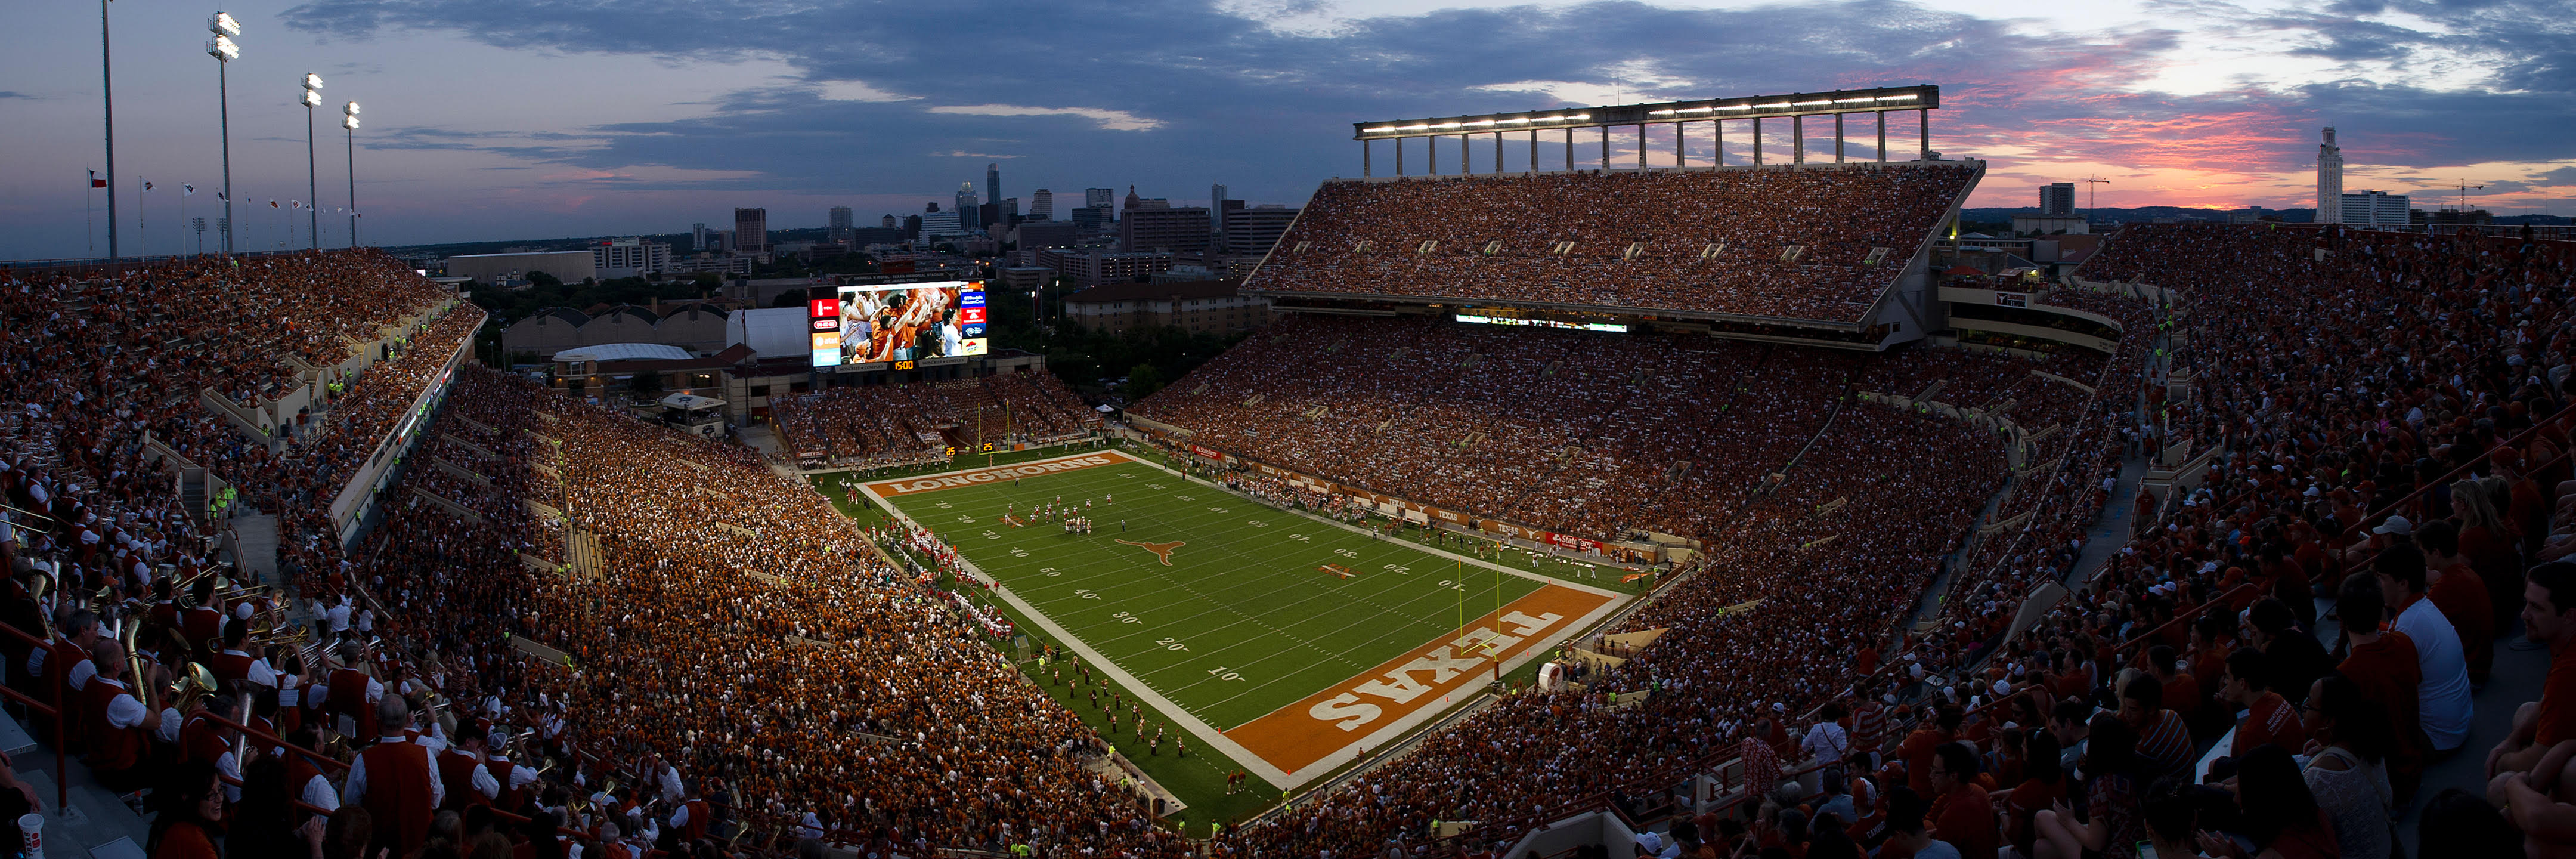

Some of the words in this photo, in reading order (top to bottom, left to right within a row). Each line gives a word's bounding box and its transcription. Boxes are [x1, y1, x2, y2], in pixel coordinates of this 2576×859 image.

[895, 360, 914, 370] 15:00
[946, 447, 955, 455] 25
[984, 443, 993, 451] 25
[890, 456, 1111, 493] LONGHORNS
[1261, 465, 1275, 474] TEXAS
[1300, 475, 1315, 485] TEXAS
[1388, 498, 1406, 509] TEXAS
[1438, 510, 1457, 521] TEXAS
[982, 530, 1001, 539] 30
[1498, 523, 1519, 535] TEXAS
[1009, 548, 1029, 557] 40
[1039, 567, 1061, 577] 50
[1383, 564, 1410, 573] 20
[1074, 589, 1098, 600] 40
[1112, 611, 1138, 624] 30
[1155, 637, 1185, 651] 20
[1208, 666, 1239, 681] 10
[1309, 610, 1564, 732] TEXAS
[24, 832, 33, 857] TEXAS
